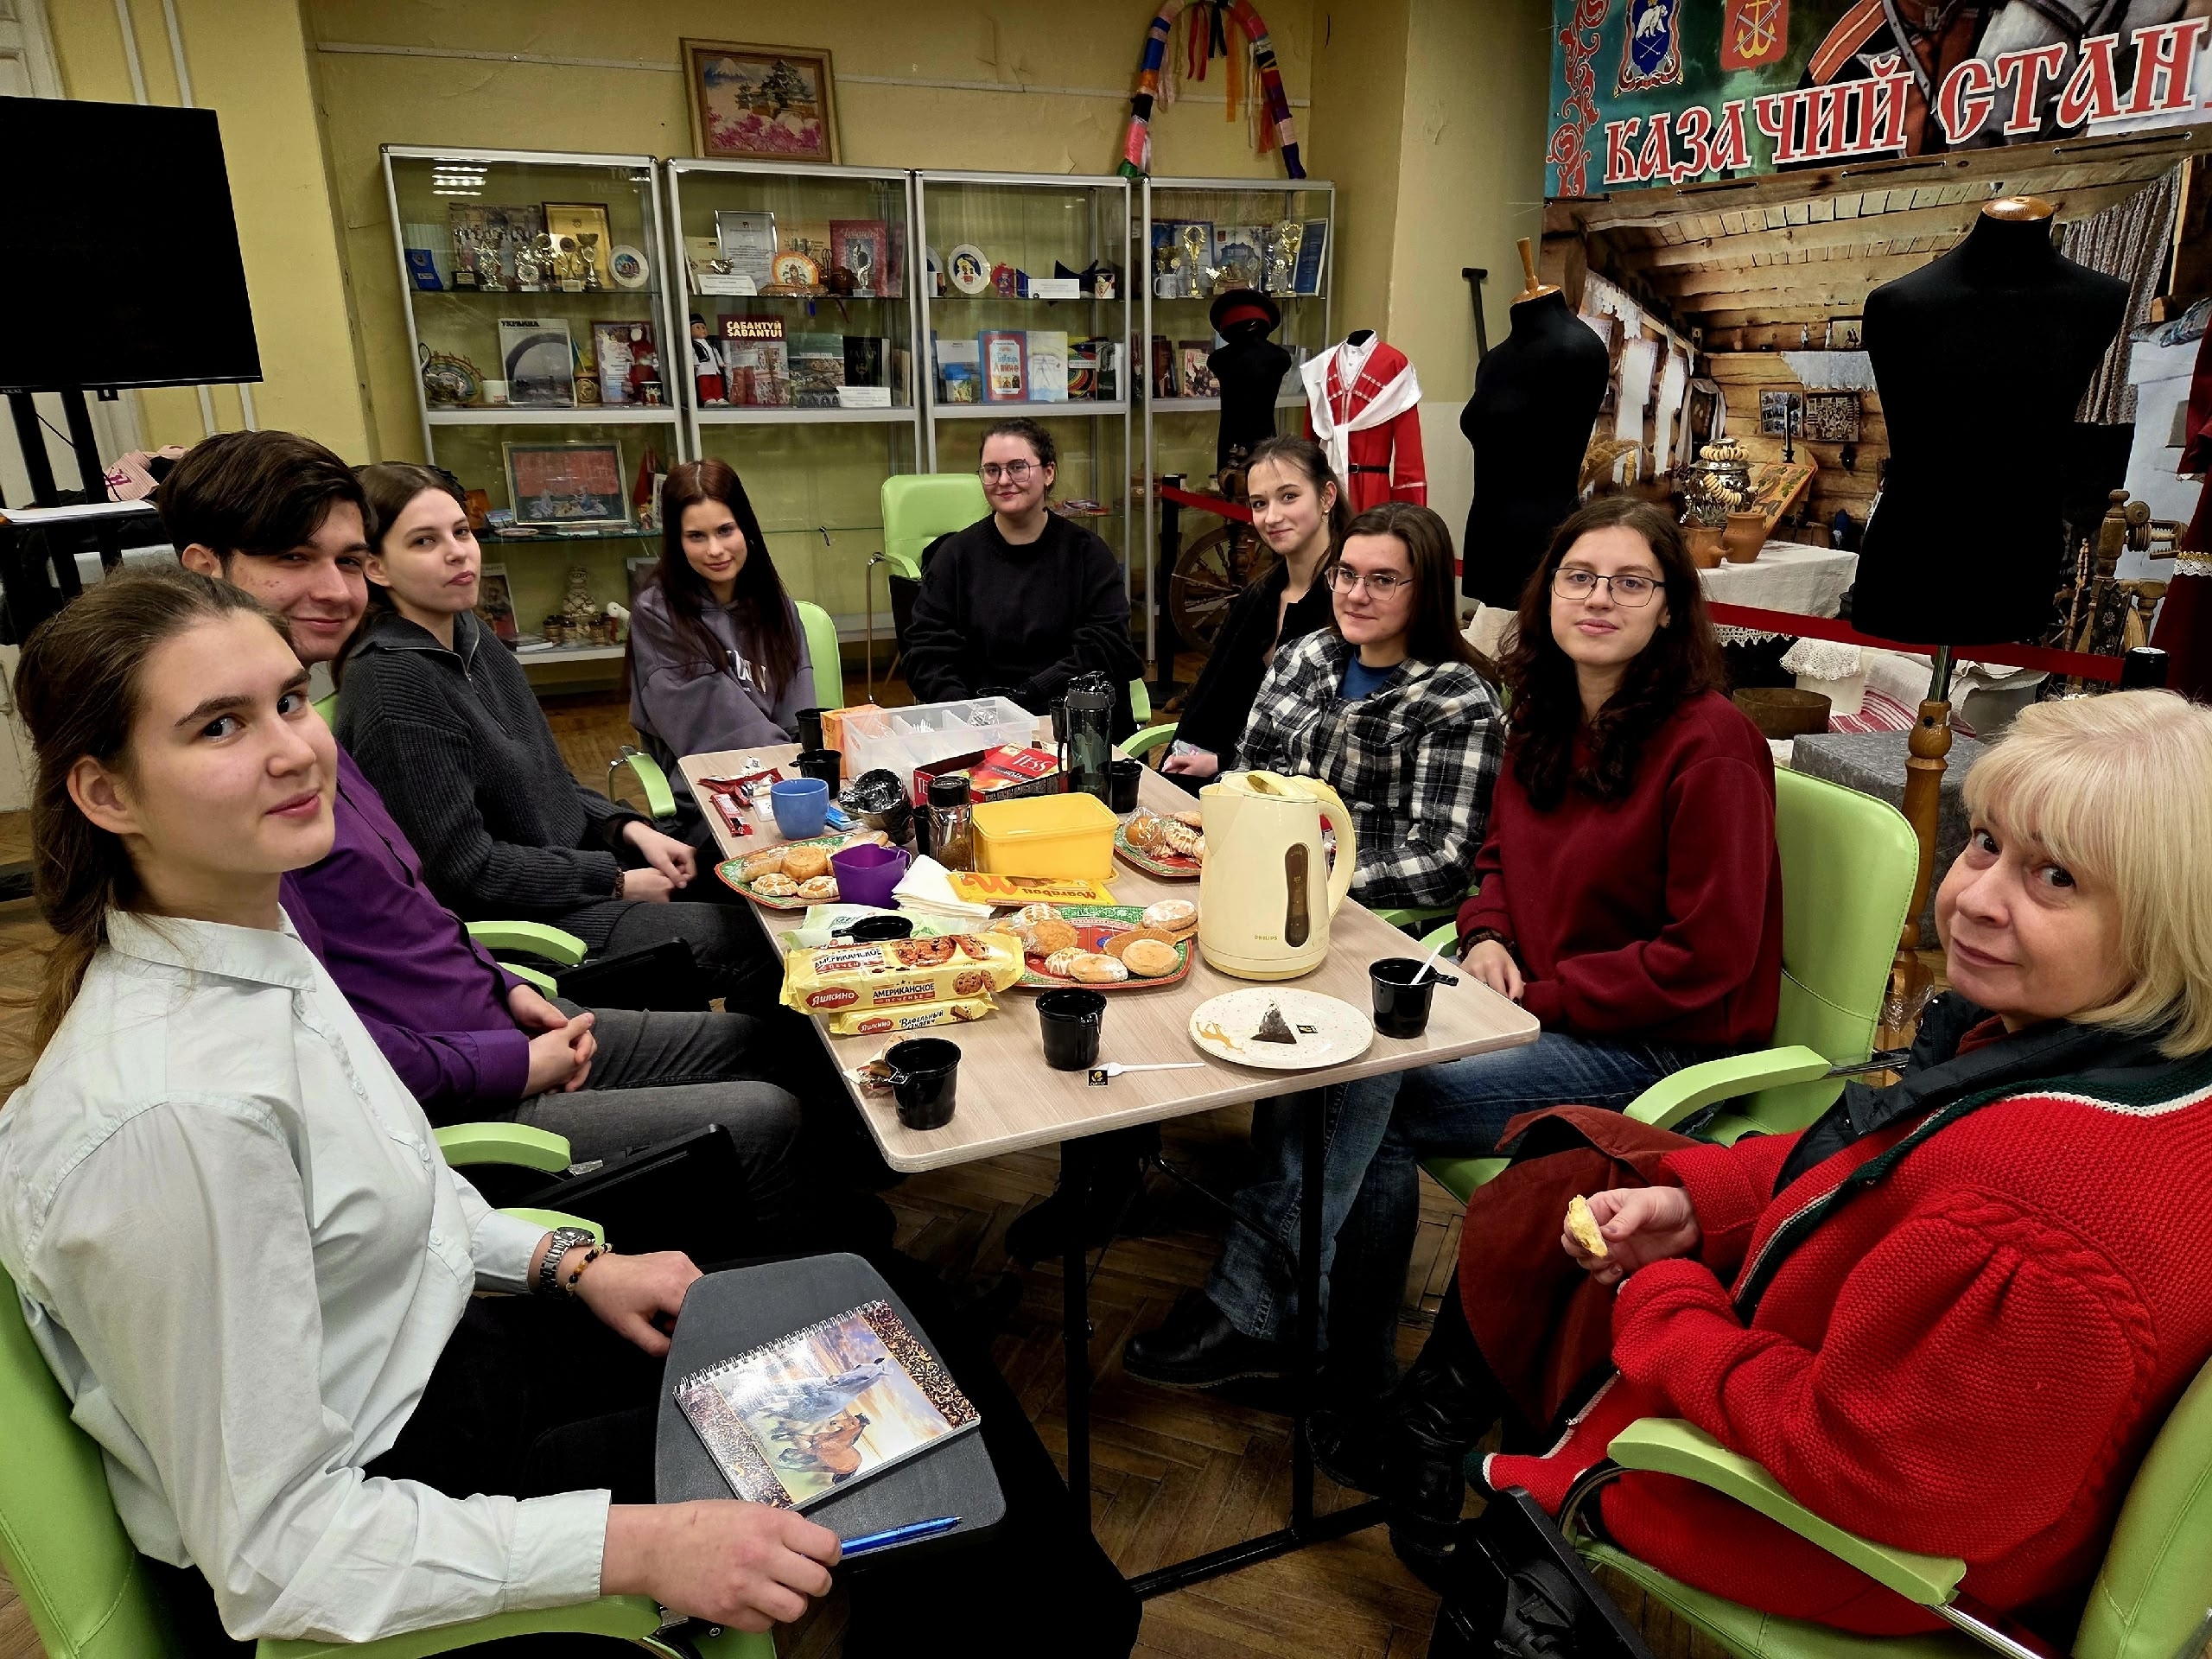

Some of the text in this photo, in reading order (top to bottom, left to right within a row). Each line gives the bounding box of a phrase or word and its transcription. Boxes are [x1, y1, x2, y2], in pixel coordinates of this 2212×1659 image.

[1604, 16, 2210, 185] КАЗАЧИЙ СТАН
[727, 321, 781, 329] САБАНТУЙ
[1012, 753, 1053, 772] TESS
[918, 776, 929, 795] TE
[1022, 888, 1096, 899] Marabou
[815, 948, 882, 969] АМЕРИКАНСКОЕ
[873, 983, 935, 998] АМЕРИКАНСКОЕ
